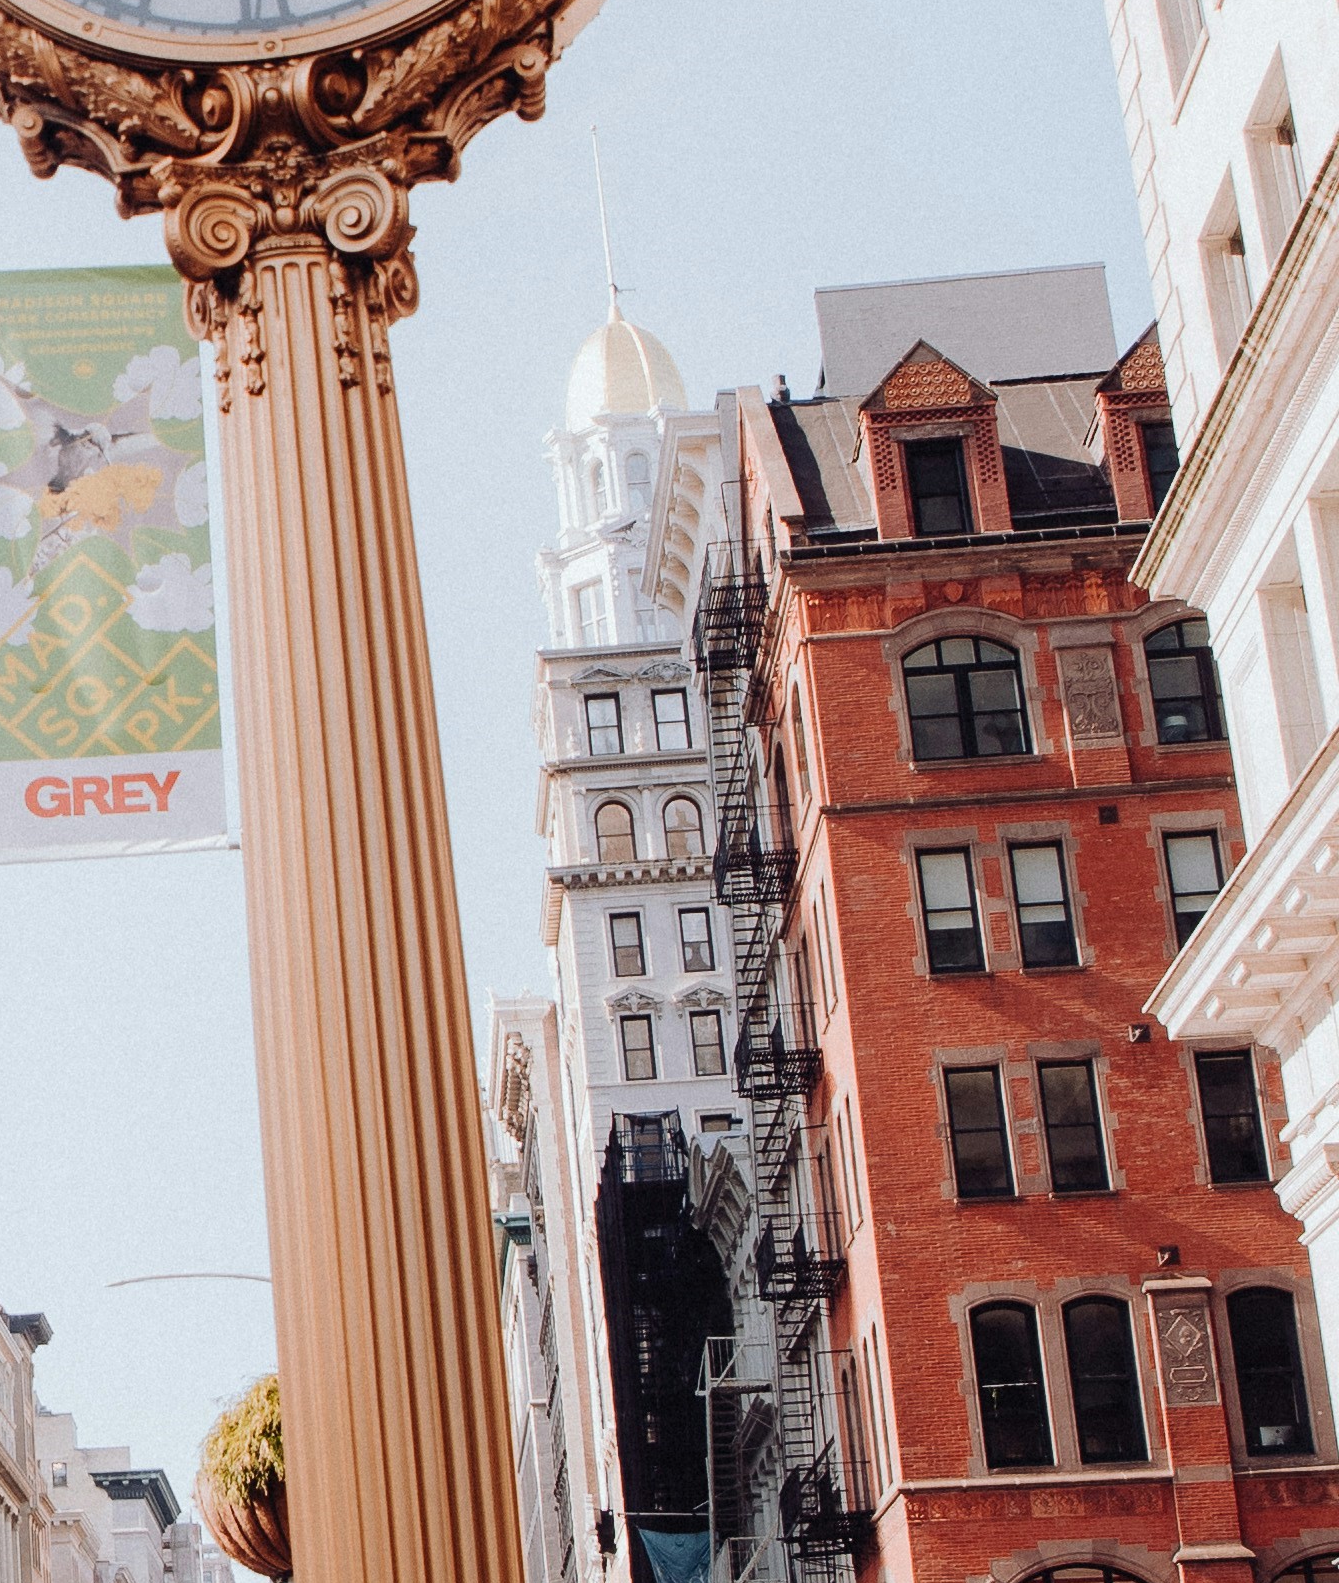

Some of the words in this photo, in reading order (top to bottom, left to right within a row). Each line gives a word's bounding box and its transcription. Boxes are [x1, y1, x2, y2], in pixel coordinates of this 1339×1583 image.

[90, 292, 167, 306] SQUARE
[38, 675, 126, 747] SQ.
[125, 676, 213, 751] PK.
[24, 770, 181, 818] GREY
